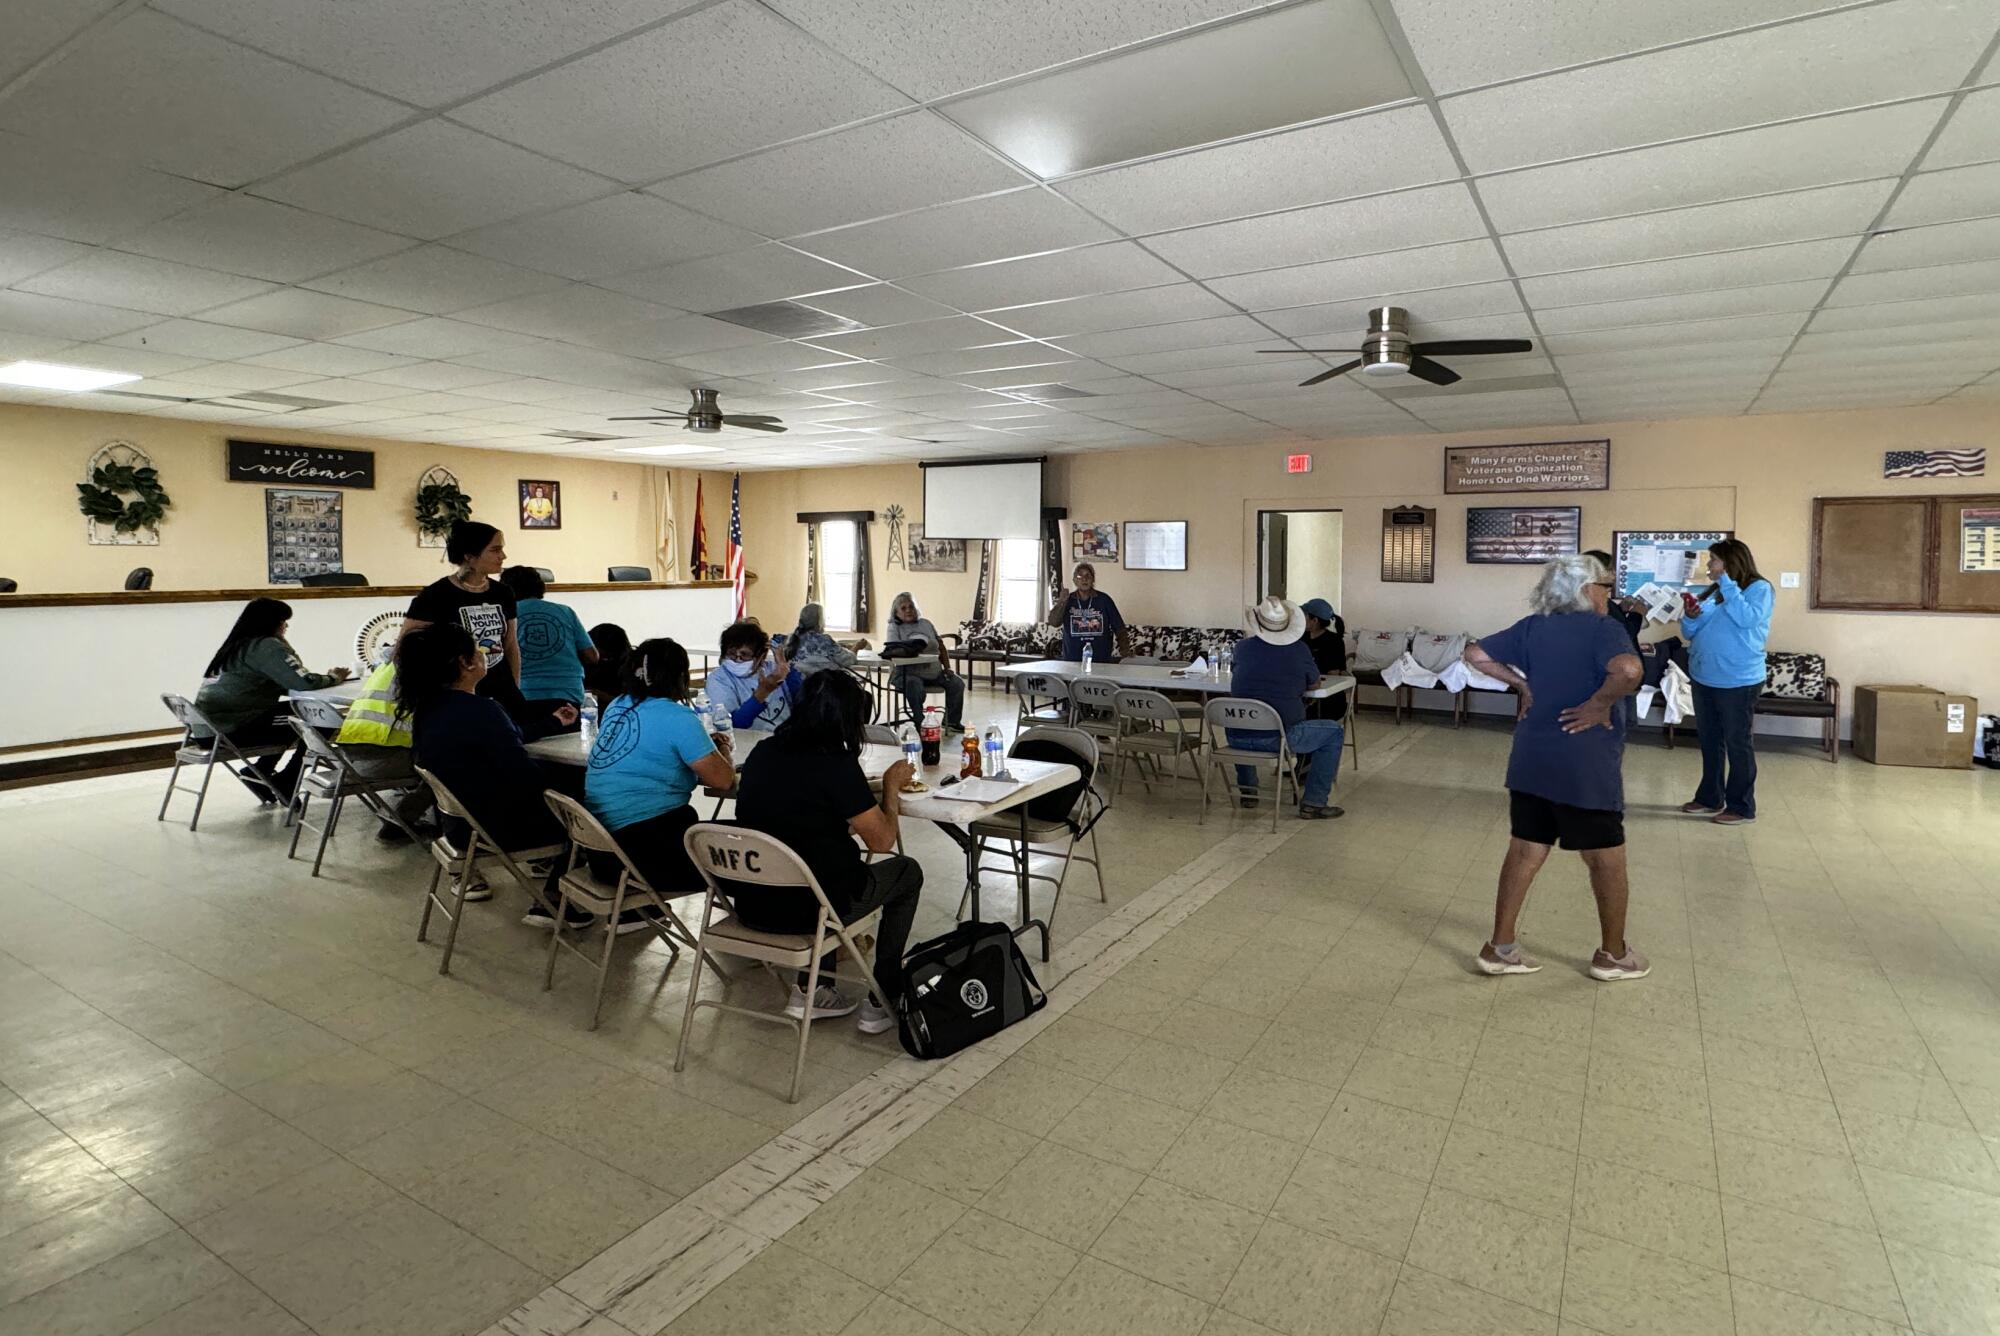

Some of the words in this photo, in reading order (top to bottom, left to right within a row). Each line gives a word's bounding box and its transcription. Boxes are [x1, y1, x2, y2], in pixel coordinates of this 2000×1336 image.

[265, 449, 309, 457] HELLO
[1471, 456, 1499, 465] Many
[1501, 455, 1533, 464] Farms
[1534, 454, 1578, 463] Chapter
[239, 458, 365, 479] welcome
[1466, 465, 1513, 475] Veterans
[1514, 464, 1583, 474] Organization
[1459, 477, 1495, 485] Honors
[1496, 476, 1514, 484] Our
[1540, 474, 1590, 483] Warriors
[470, 613, 500, 622] NATIVE
[1027, 678, 1047, 692] MFC
[1083, 686, 1108, 697] MFC
[1126, 699, 1155, 710] MFC
[1225, 707, 1259, 720] MFC
[708, 845, 762, 873] MFC
